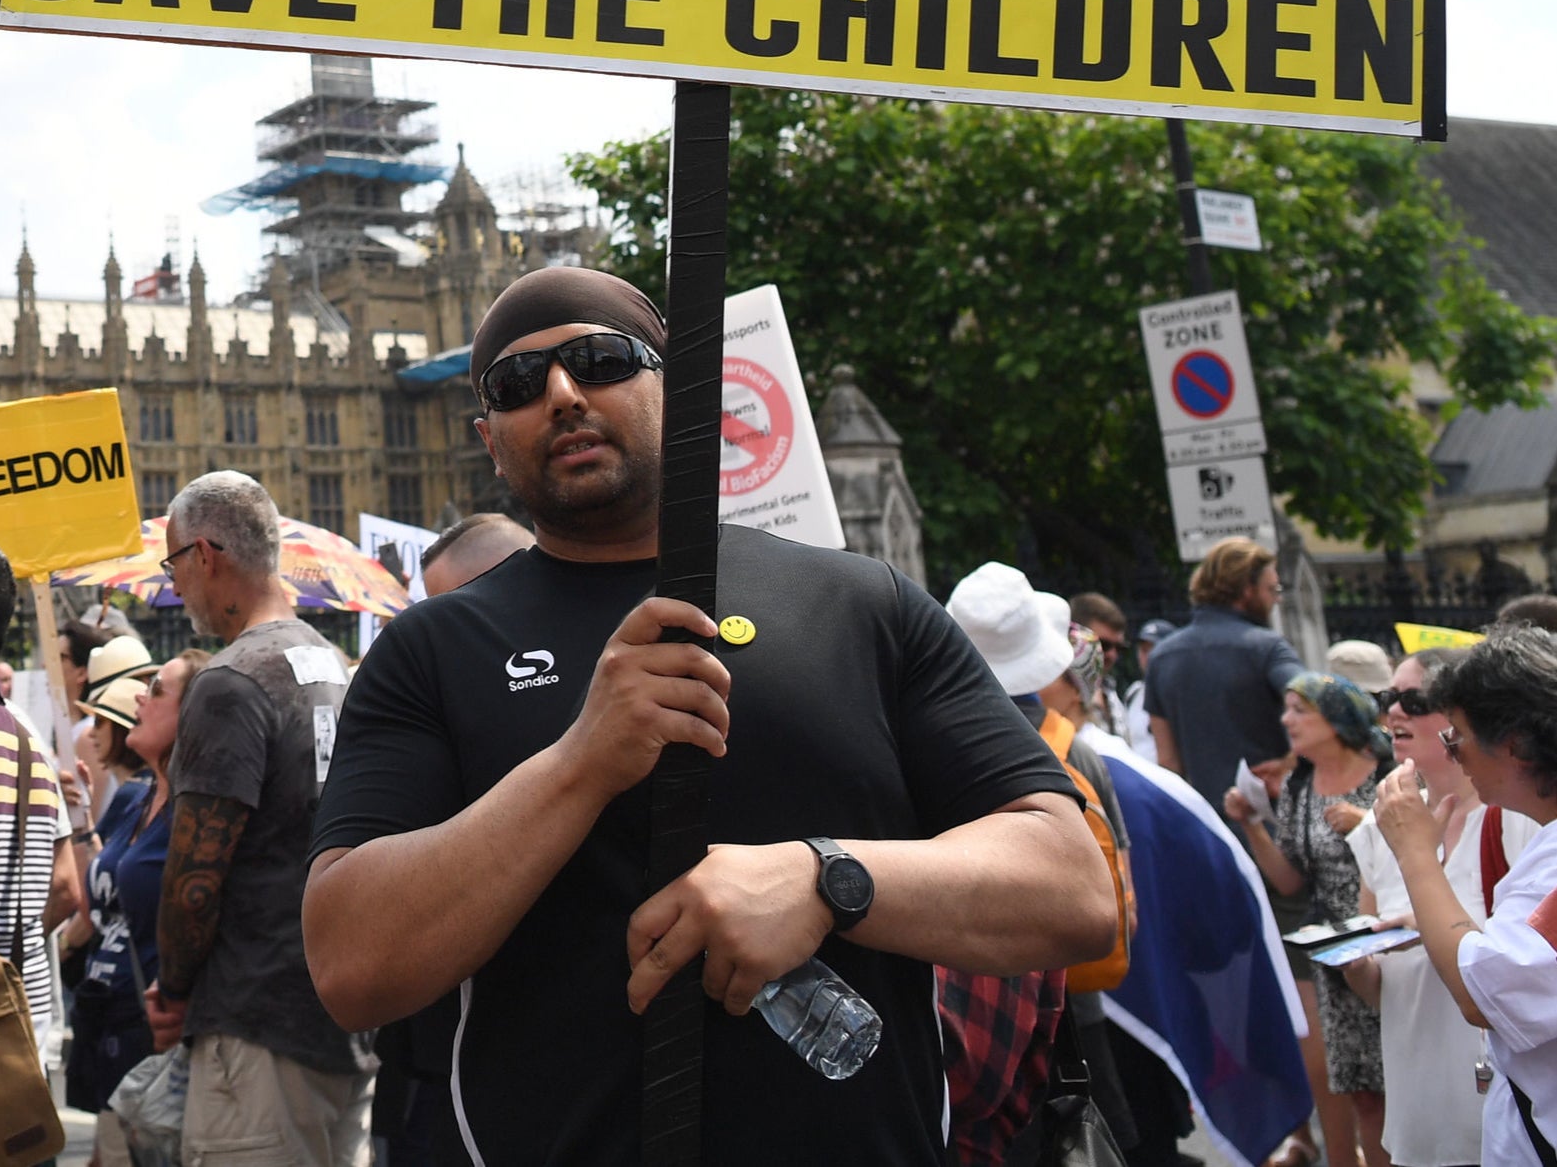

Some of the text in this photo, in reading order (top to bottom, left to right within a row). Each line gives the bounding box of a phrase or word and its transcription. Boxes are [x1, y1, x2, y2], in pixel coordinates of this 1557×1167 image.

[1165, 320, 1223, 348] ZONE
[719, 498, 778, 522] perimental
[774, 514, 798, 526] Kids
[508, 674, 560, 692] Sondico
